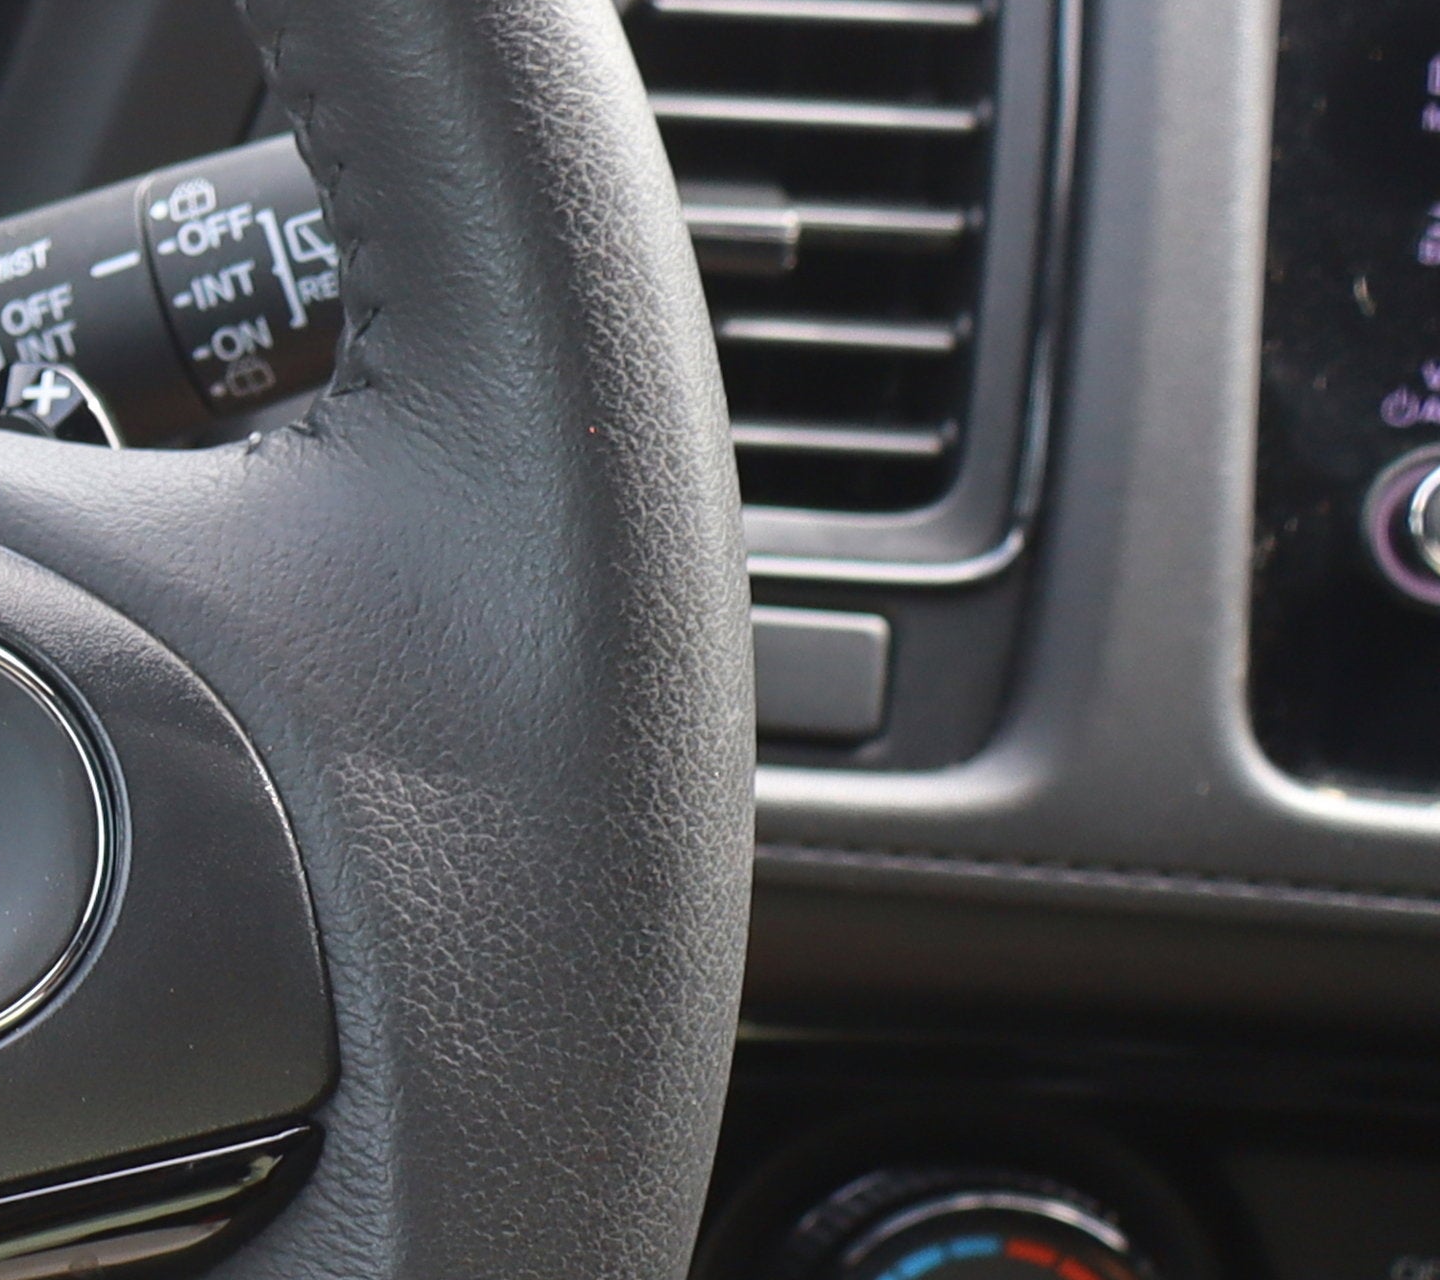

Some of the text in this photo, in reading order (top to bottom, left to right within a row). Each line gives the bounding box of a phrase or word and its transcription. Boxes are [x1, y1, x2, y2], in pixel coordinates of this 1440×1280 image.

[177, 201, 253, 258] OFF
[0, 281, 74, 338] OFF
[190, 259, 257, 312] INT
[14, 319, 78, 364] INT
[210, 315, 275, 363] ON
